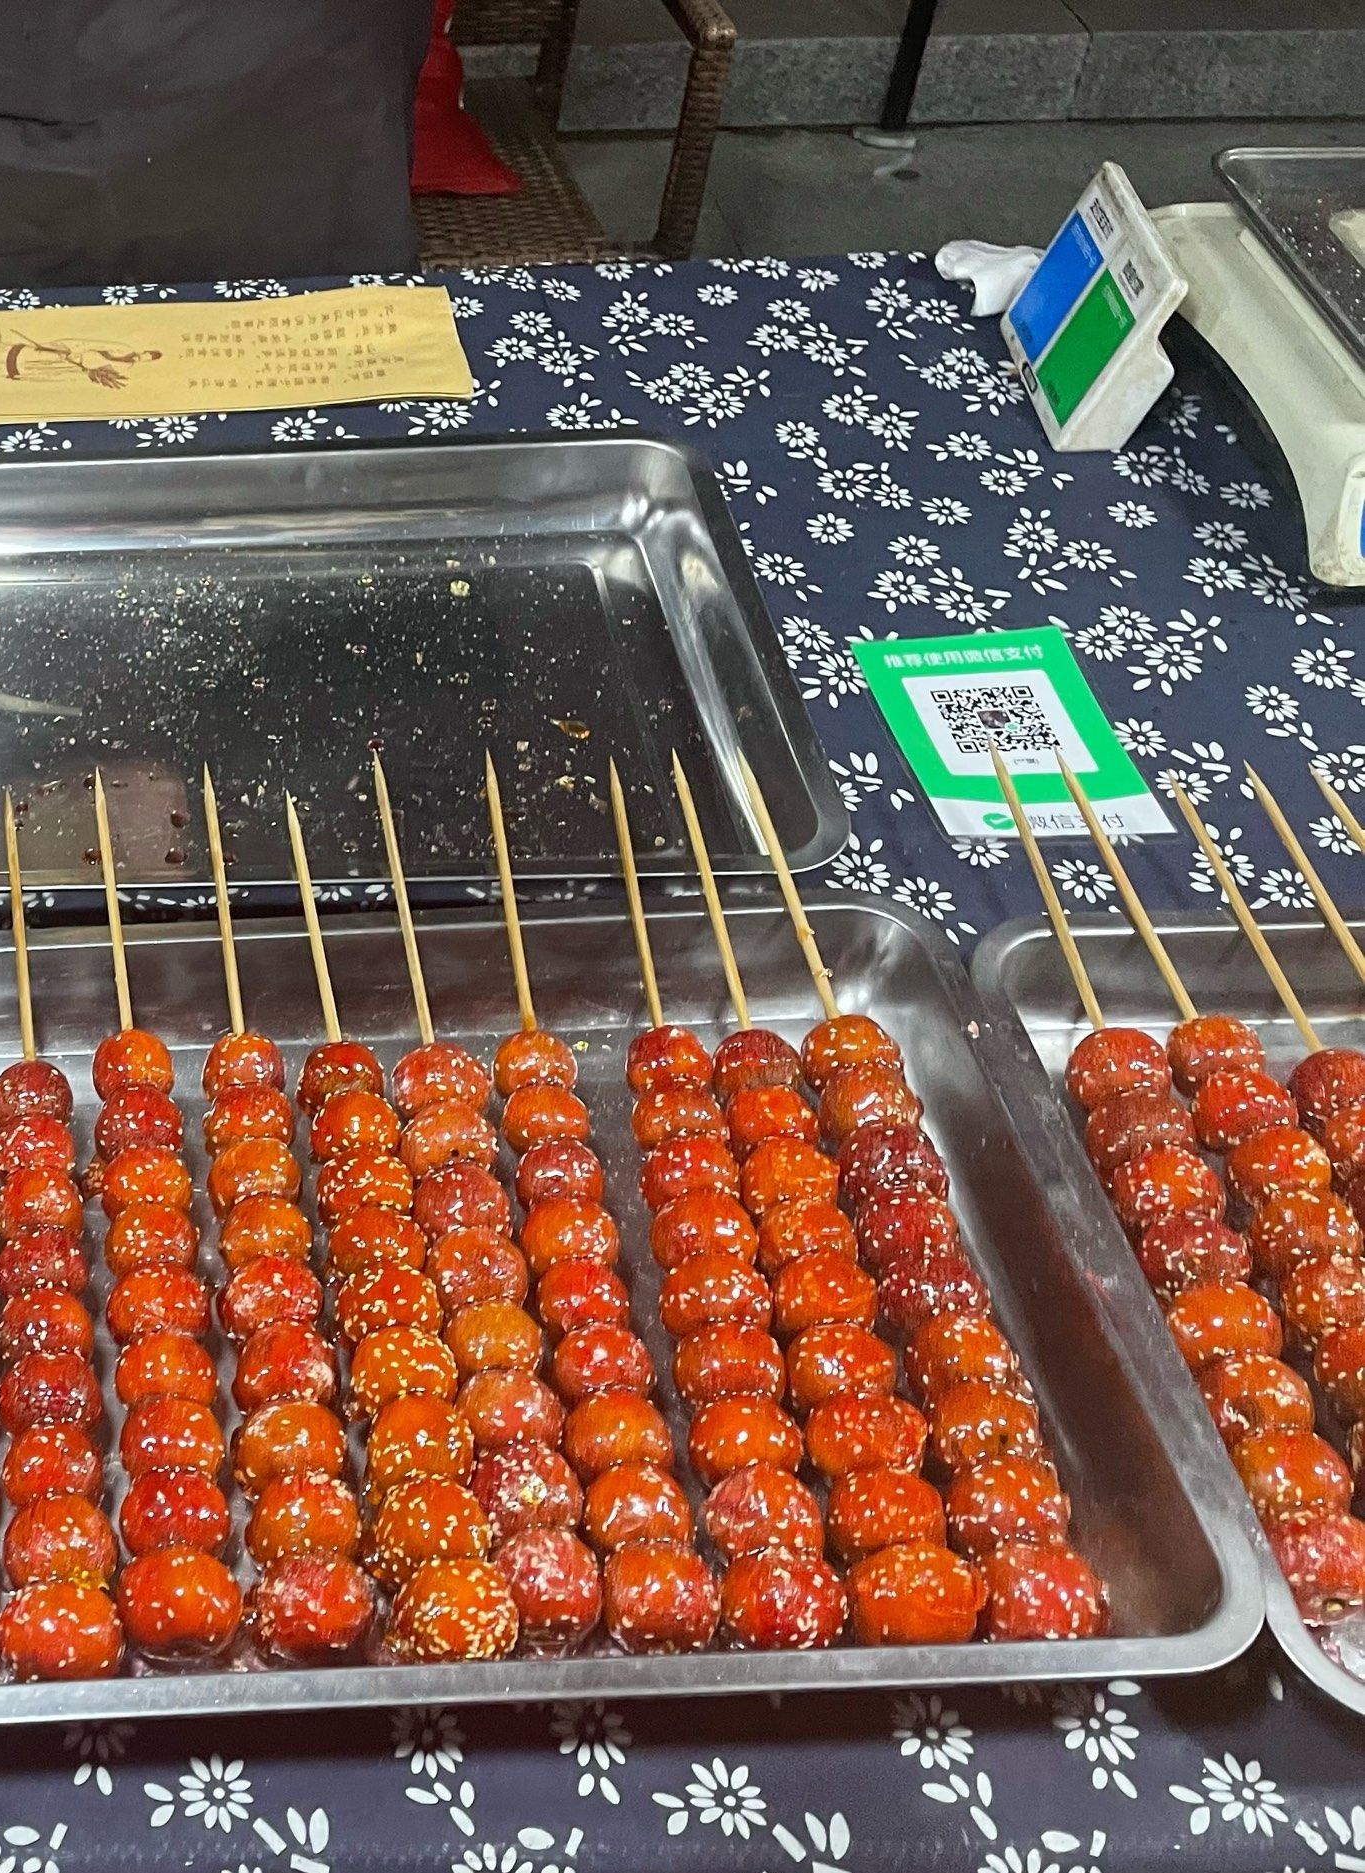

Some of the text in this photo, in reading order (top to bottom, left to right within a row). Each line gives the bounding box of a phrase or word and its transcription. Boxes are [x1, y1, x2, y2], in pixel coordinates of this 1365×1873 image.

[883, 644, 1044, 669] 推荐使用微信支付
